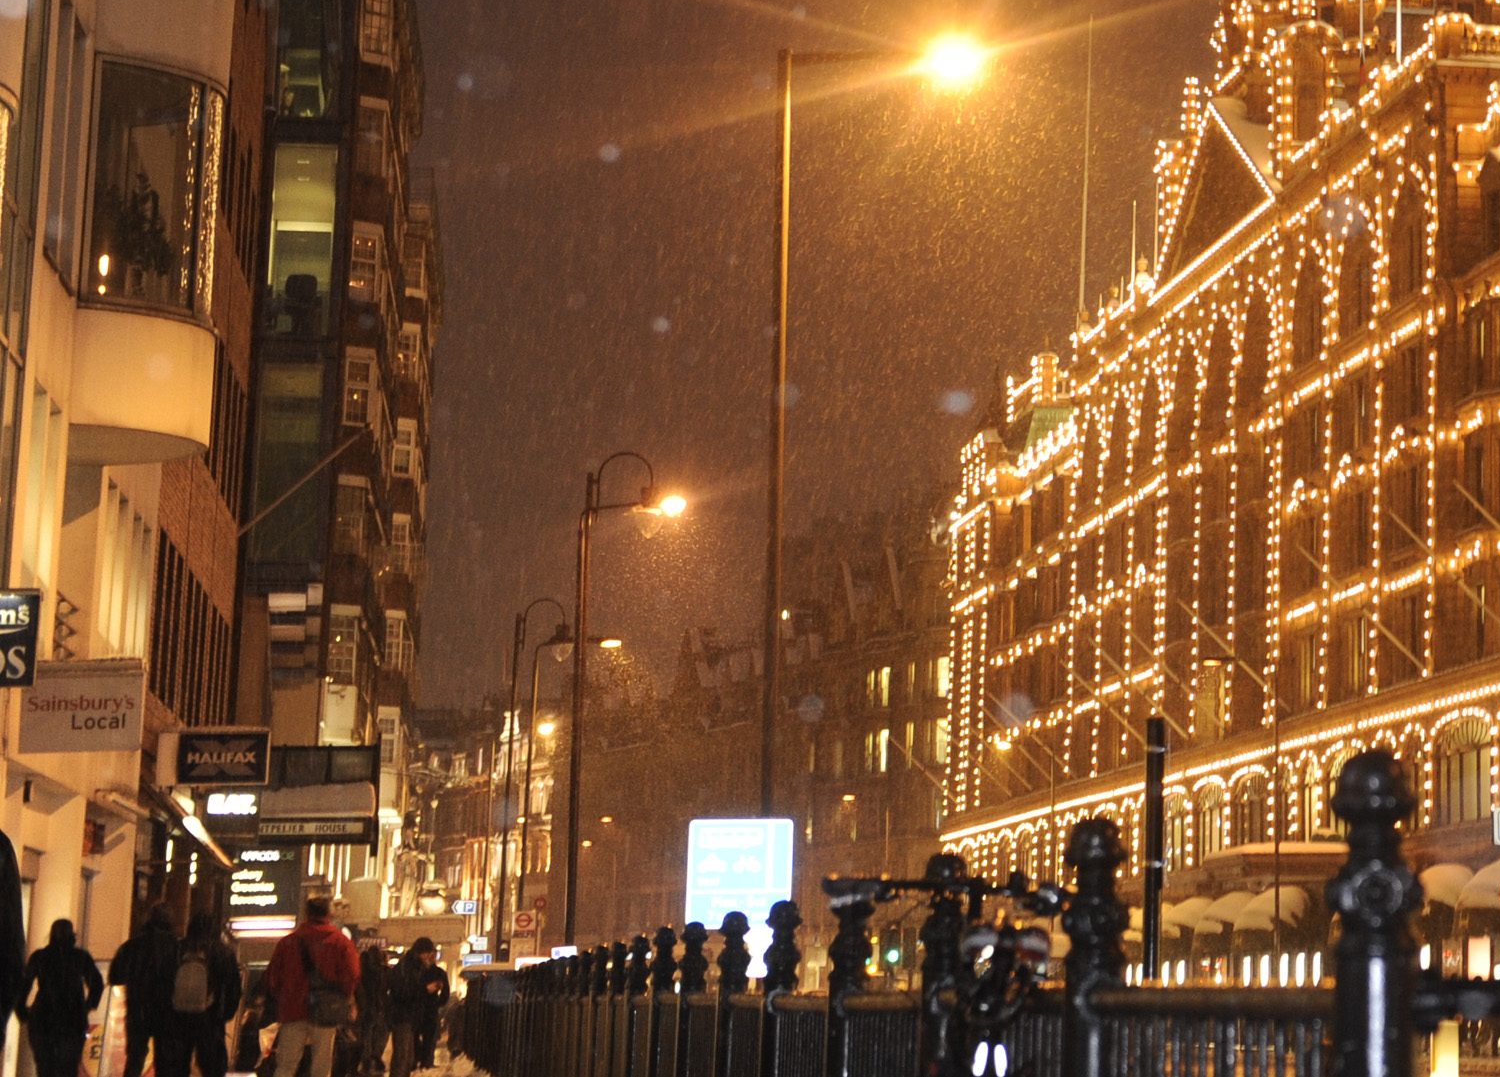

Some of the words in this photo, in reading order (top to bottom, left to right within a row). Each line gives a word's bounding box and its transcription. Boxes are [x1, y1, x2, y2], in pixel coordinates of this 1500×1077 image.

[27, 694, 136, 713] Sainsbury's
[71, 713, 126, 730] Local
[187, 751, 255, 764] HALIFAX
[315, 824, 348, 834] HOUSE
